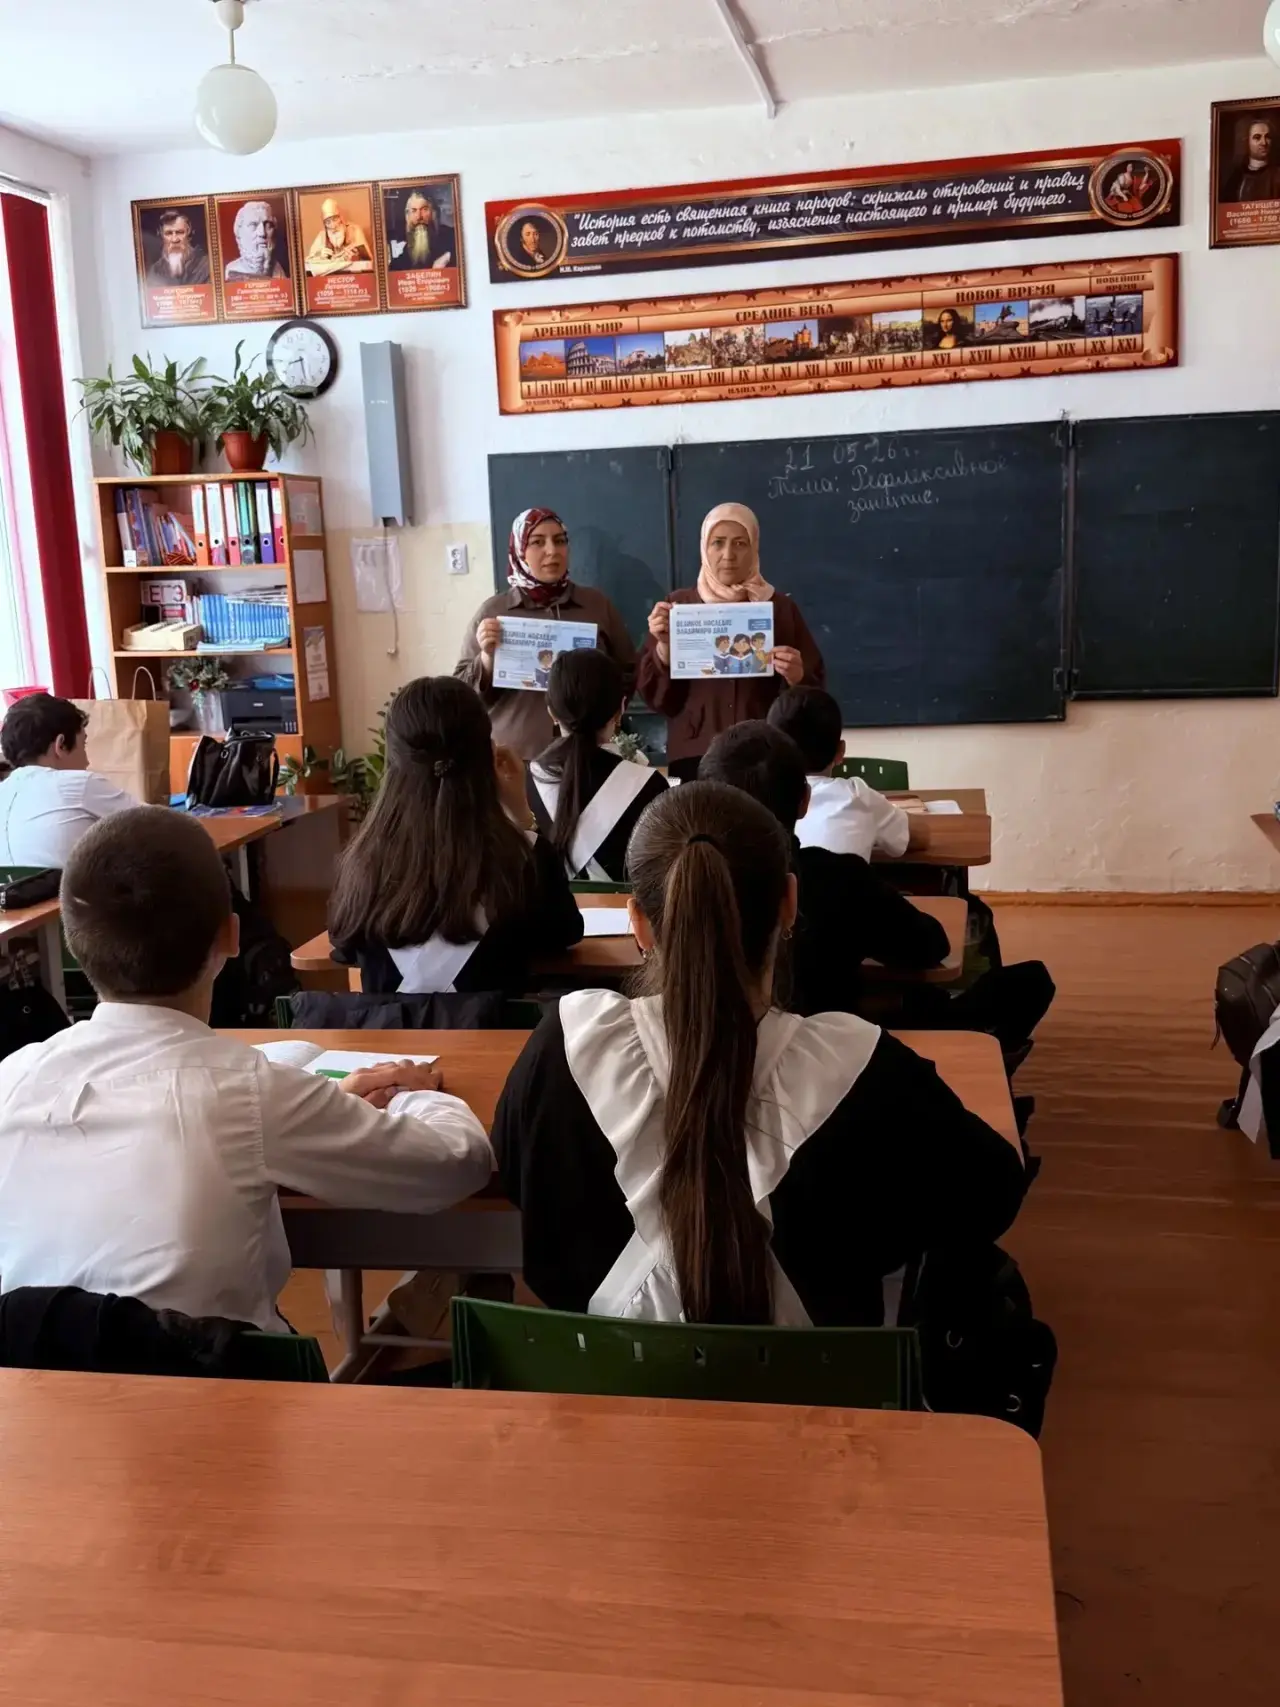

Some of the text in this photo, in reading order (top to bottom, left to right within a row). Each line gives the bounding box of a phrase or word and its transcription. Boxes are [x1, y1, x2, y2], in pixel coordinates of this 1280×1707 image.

[574, 171, 1085, 233] "История есть священная книга народов: скрижаль откровений и правил
[571, 231, 610, 247] завет
[614, 225, 666, 248] предков
[669, 228, 678, 239] к
[682, 217, 760, 238] потомству,
[768, 213, 841, 230] изъяснение
[845, 205, 927, 223] настоящего
[932, 204, 941, 215] и
[947, 197, 998, 219] пример
[956, 284, 1055, 303] НОВОЕ ВРЕМЯ
[596, 322, 623, 333] МИР
[736, 304, 835, 322] СРЕДНИЕ ВЕКА
[601, 380, 612, 391] III
[620, 379, 630, 390] IV
[640, 376, 647, 387] V
[658, 376, 668, 387] VI
[680, 374, 694, 386] VII
[706, 371, 725, 384] VIII
[739, 370, 751, 382] IX
[762, 368, 769, 380] X
[780, 367, 792, 378] XI
[805, 364, 820, 377] XII
[834, 361, 853, 373] XIII
[867, 358, 885, 371] XIV
[902, 355, 917, 368] XV
[932, 352, 950, 366] XVI
[969, 349, 992, 364] XVII
[1008, 346, 1036, 360] XVIII
[1056, 343, 1076, 356] XIX
[1090, 340, 1106, 354] XX
[1117, 338, 1137, 351] XXI
